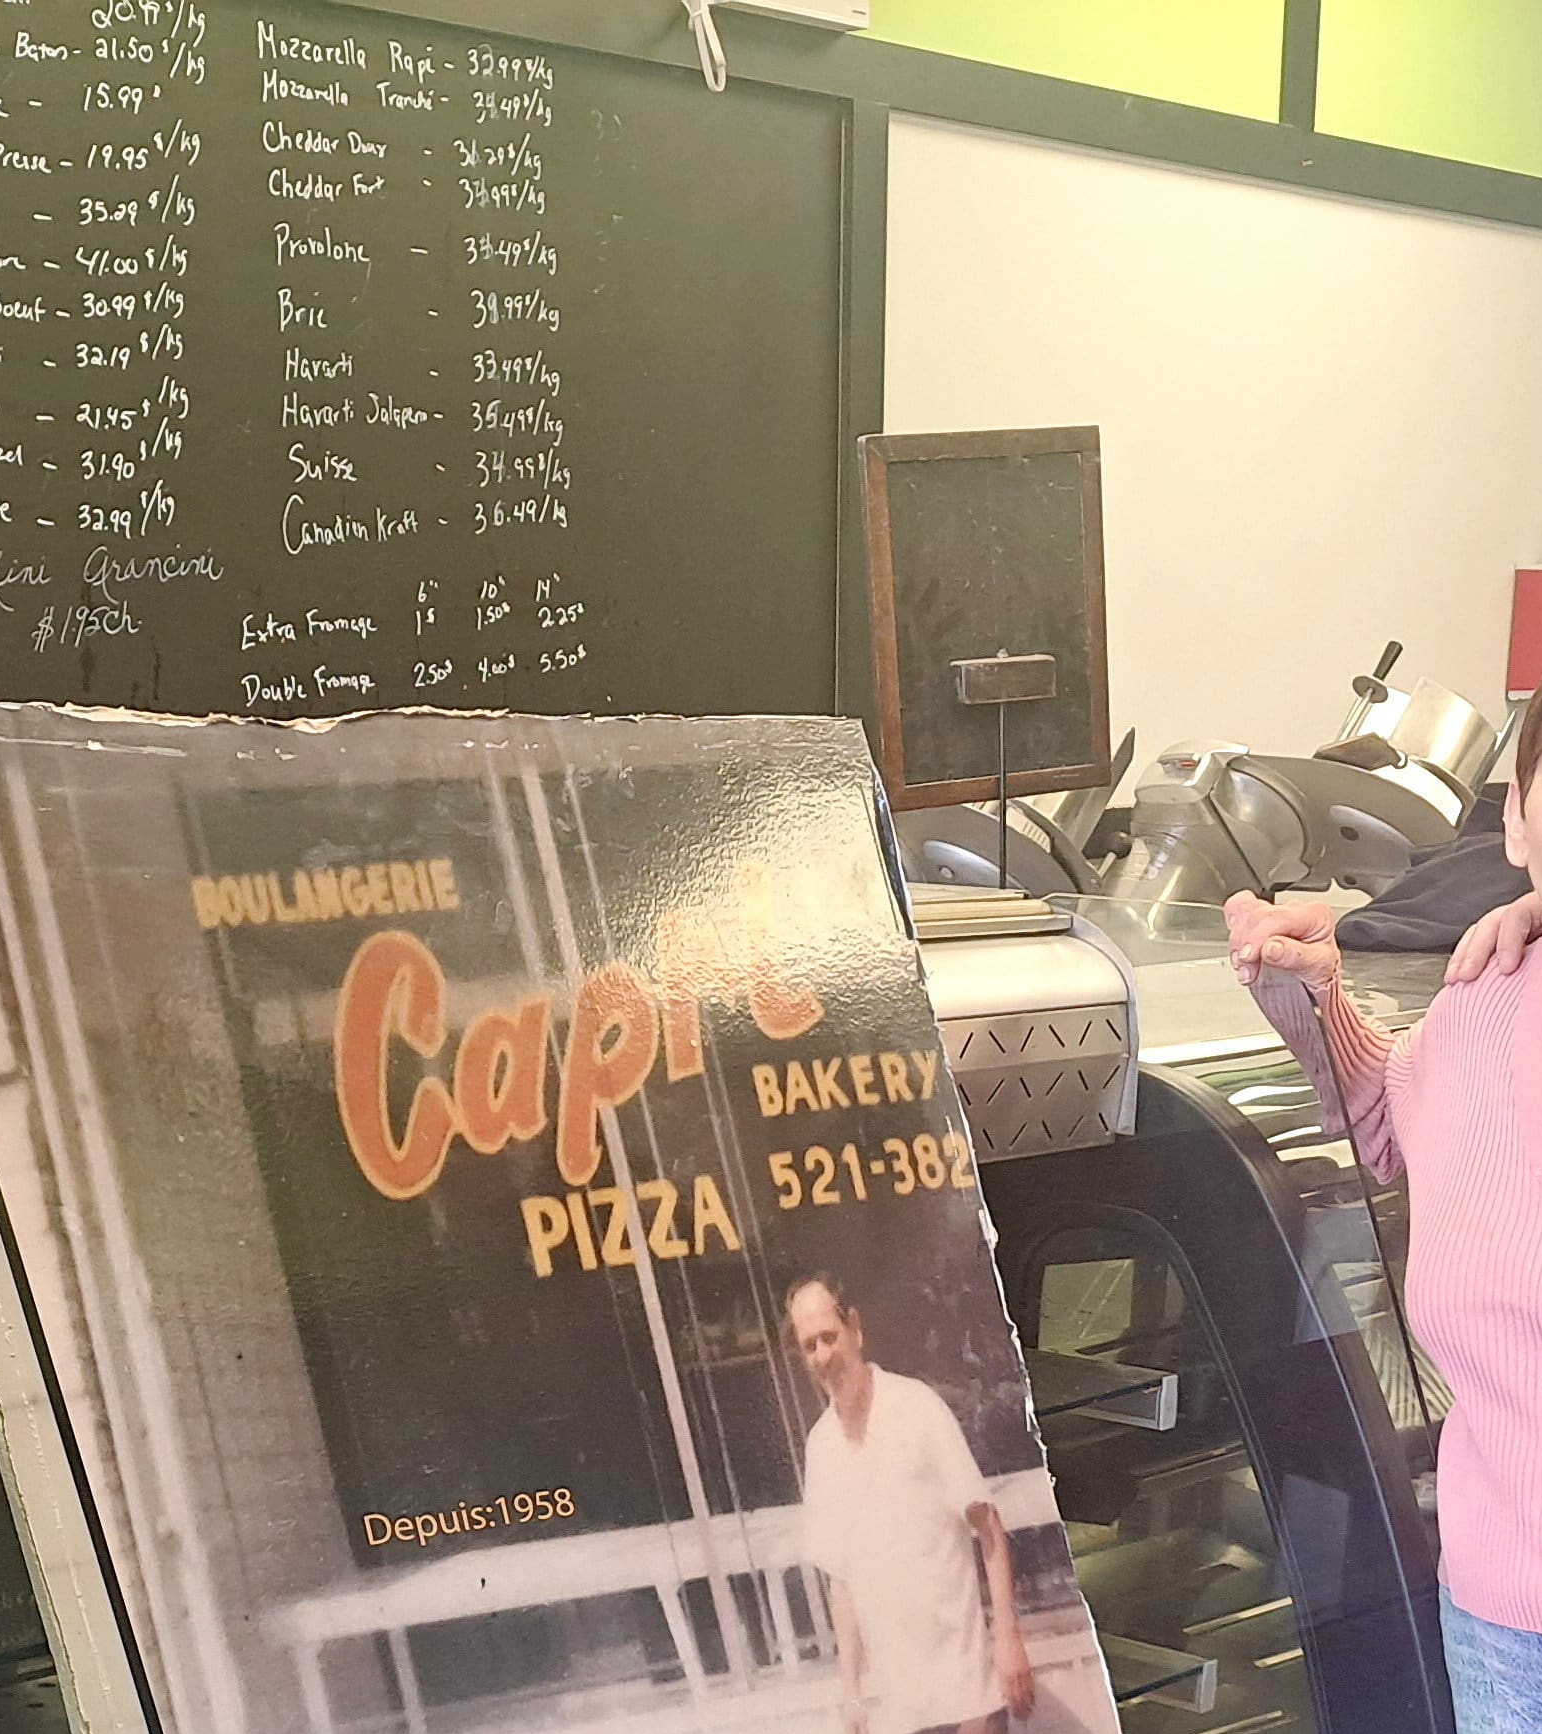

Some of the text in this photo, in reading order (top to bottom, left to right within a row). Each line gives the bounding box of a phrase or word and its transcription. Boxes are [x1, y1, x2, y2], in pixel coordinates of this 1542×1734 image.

[257, 20, 367, 70] Mozzarella
[262, 68, 349, 107] Mozzarella
[262, 120, 340, 155] Cheddar
[268, 167, 343, 203] Cheddar
[274, 222, 371, 267] Provolone
[285, 347, 353, 382] Havarti
[281, 391, 355, 429] Havarti
[288, 442, 358, 484] Suisse
[376, 507, 419, 543] Kraft
[241, 612, 297, 651] Extra
[305, 608, 378, 640] Fromage
[240, 674, 308, 708] Double
[313, 664, 376, 698] Fromage
[192, 858, 459, 931] BOULANGERIE
[752, 1048, 939, 1118] BAKERY
[519, 1174, 741, 1278] PIZZA
[362, 1487, 575, 1547] Depuis:1958
